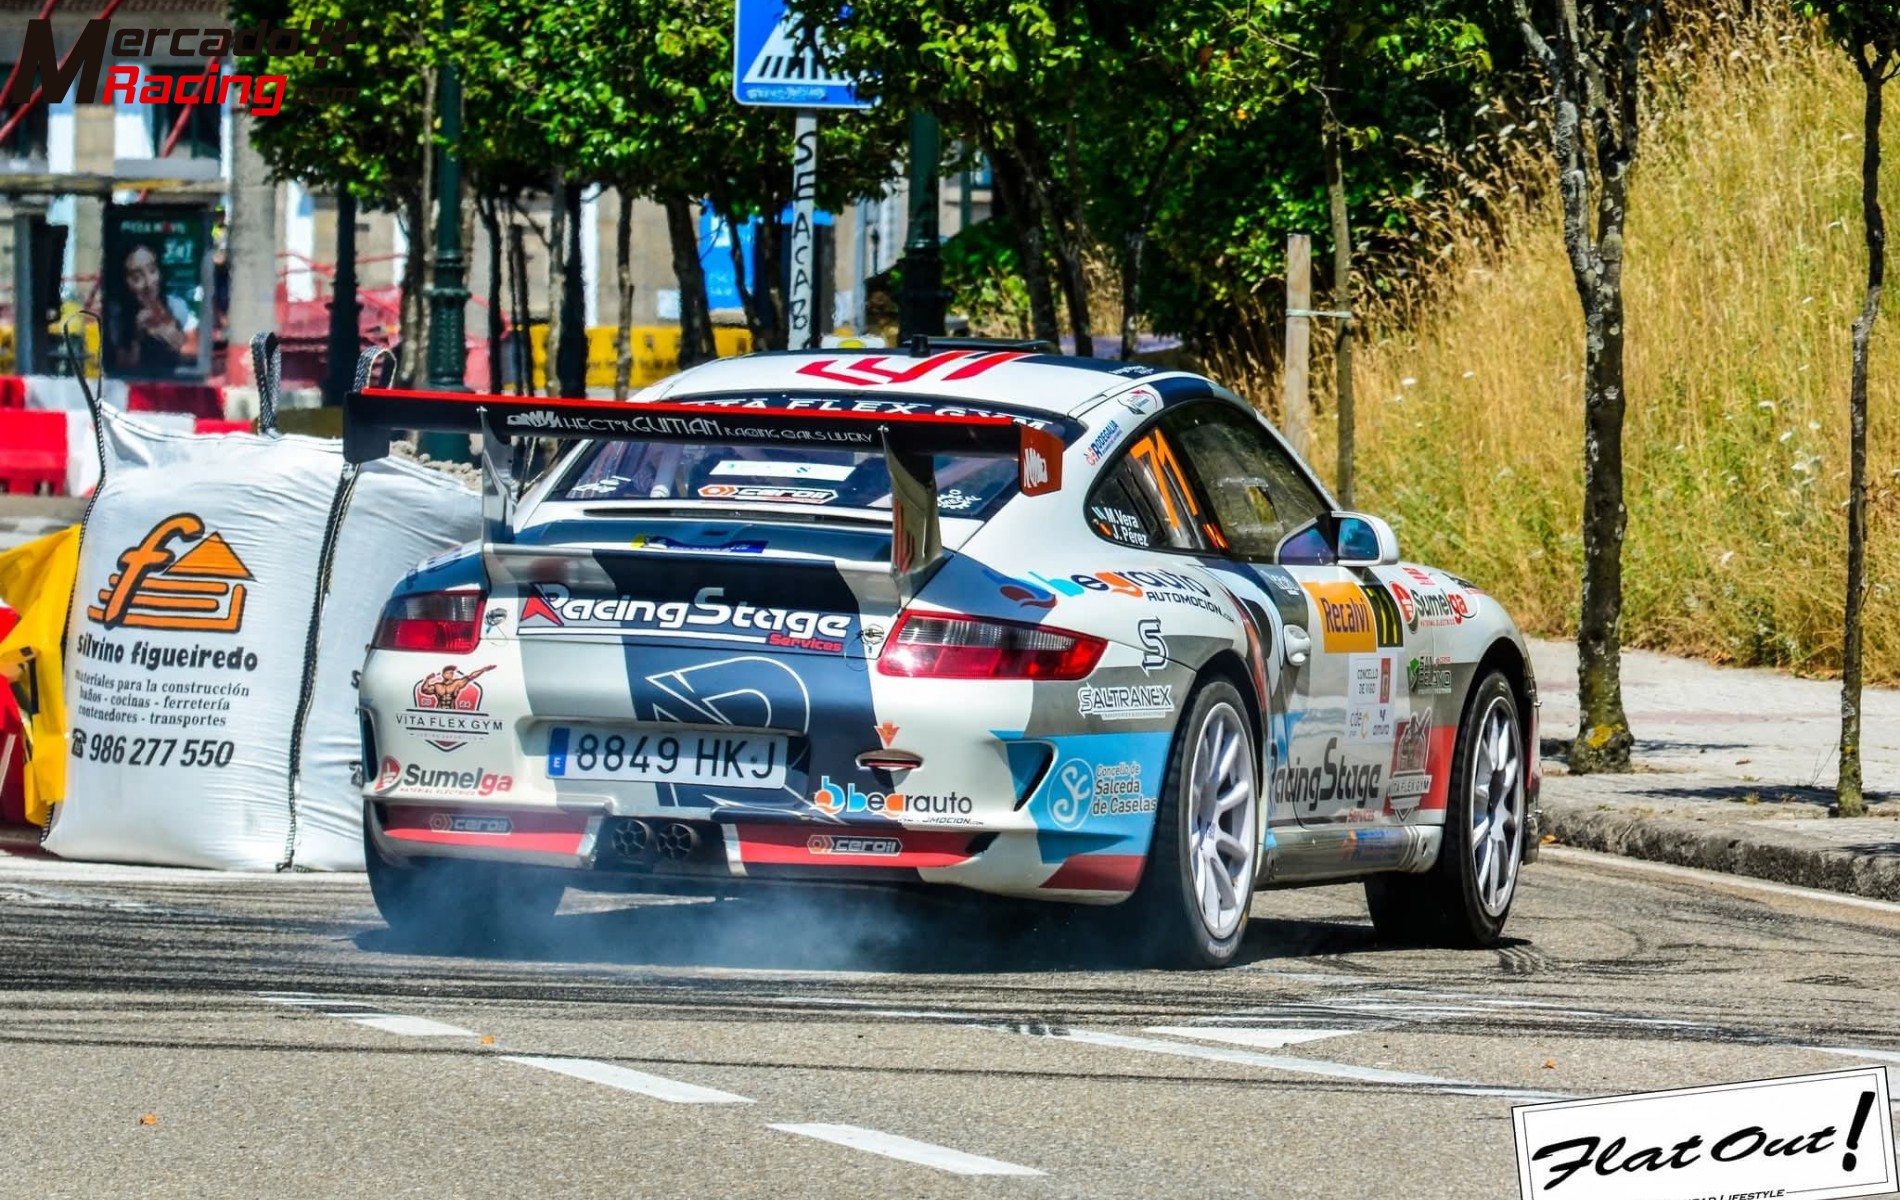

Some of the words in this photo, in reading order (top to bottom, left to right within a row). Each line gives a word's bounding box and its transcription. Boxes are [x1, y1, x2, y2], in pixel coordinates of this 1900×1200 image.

[1121, 528, 1150, 547] Pérez
[1320, 597, 1370, 633] Recalvi
[1410, 588, 1469, 624] Sumelga
[77, 632, 124, 664] silvino
[131, 641, 258, 672] figueiredo
[768, 633, 843, 652] Services
[75, 668, 114, 690] materiales
[117, 678, 142, 693] para
[146, 679, 157, 693] la
[162, 681, 250, 697] construcción
[110, 694, 151, 708] cocinas
[163, 696, 231, 711] ferretería
[1079, 683, 1174, 714] SALTRANEX
[78, 703, 138, 724] contenedores
[150, 711, 227, 728] transportes
[396, 714, 425, 727] VITA
[429, 717, 467, 729] FLEX
[471, 720, 503, 731] GYM
[89, 733, 127, 764] 986
[128, 738, 178, 766] 277
[180, 739, 235, 768] 550
[553, 757, 561, 768] E
[576, 733, 680, 775] 8849
[694, 738, 776, 779] HKJ
[403, 763, 514, 796] Sumelga
[1096, 763, 1128, 777] Concello
[1095, 777, 1141, 795] Salceda
[1092, 800, 1107, 815] de
[1110, 798, 1157, 813] Caselas
